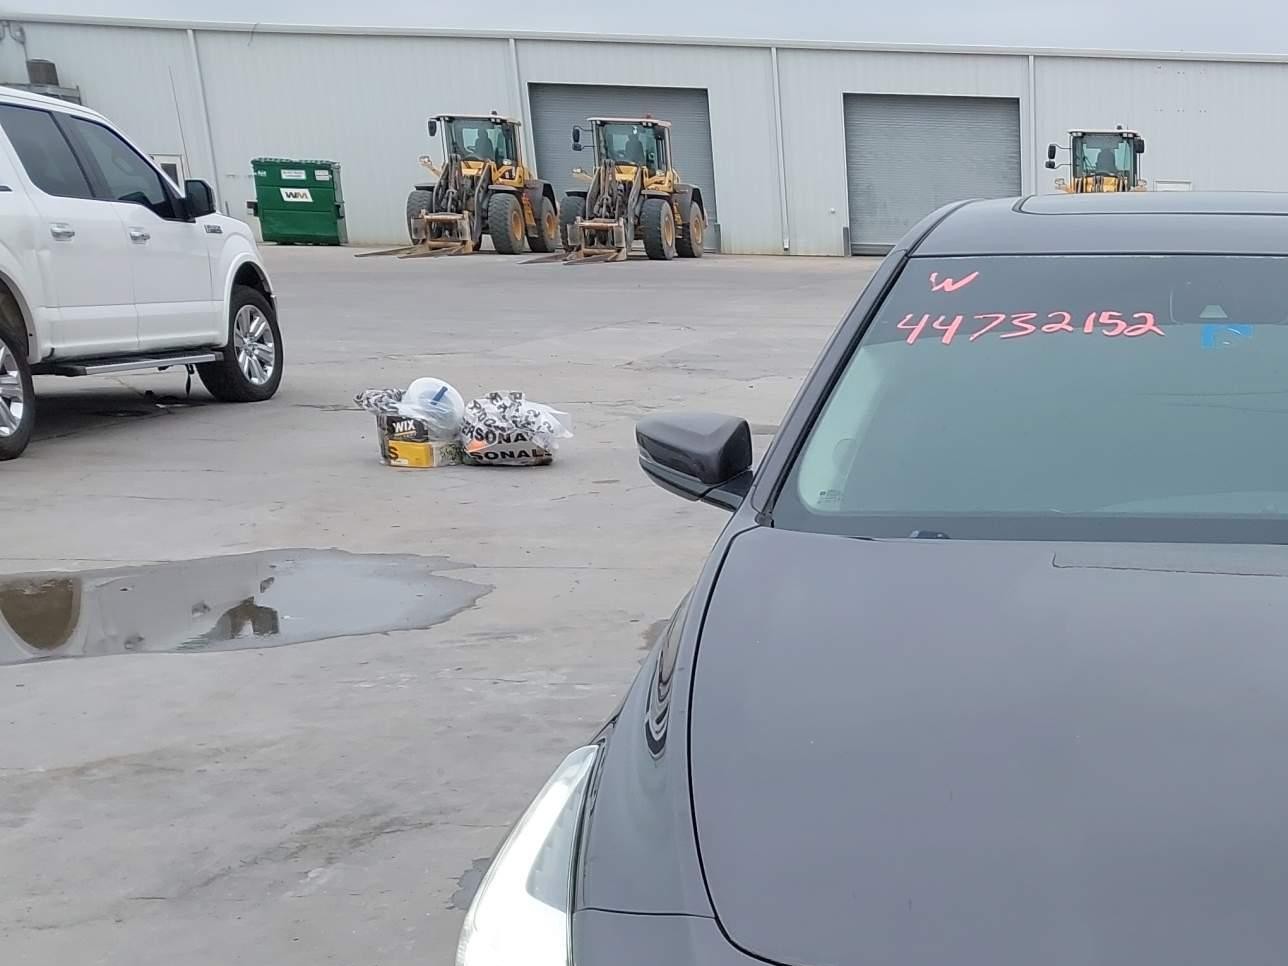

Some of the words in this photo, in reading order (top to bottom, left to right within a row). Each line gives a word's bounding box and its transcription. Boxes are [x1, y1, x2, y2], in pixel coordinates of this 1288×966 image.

[285, 191, 308, 199] WM
[930, 271, 979, 292] W
[897, 311, 1166, 345] 44732152
[392, 419, 417, 433] WIX
